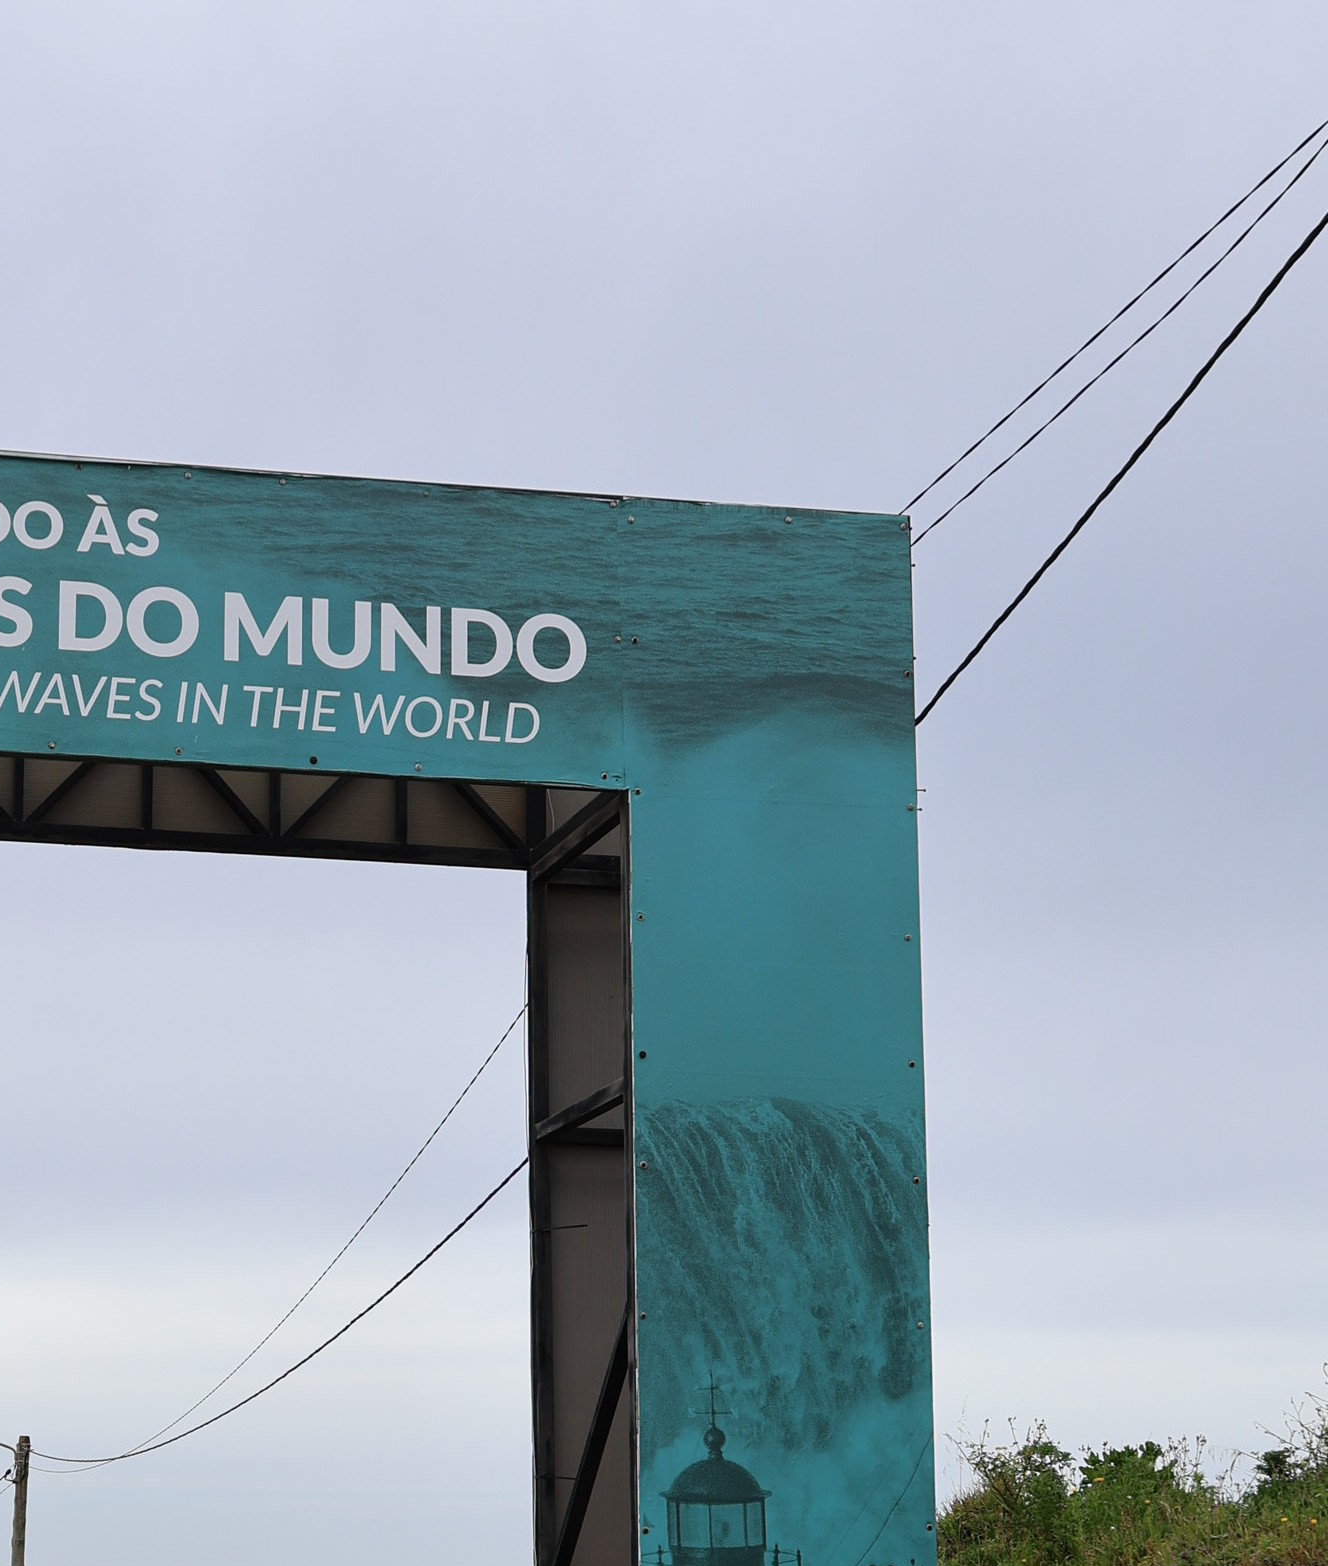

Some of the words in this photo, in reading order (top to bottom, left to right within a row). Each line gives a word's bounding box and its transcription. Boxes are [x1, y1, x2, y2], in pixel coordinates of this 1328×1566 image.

[76, 494, 160, 557] ÀS
[58, 580, 200, 658] DO
[224, 592, 588, 684] MUNDO
[176, 681, 230, 726] IN
[242, 685, 342, 733] THE
[353, 692, 541, 744] WORLD
